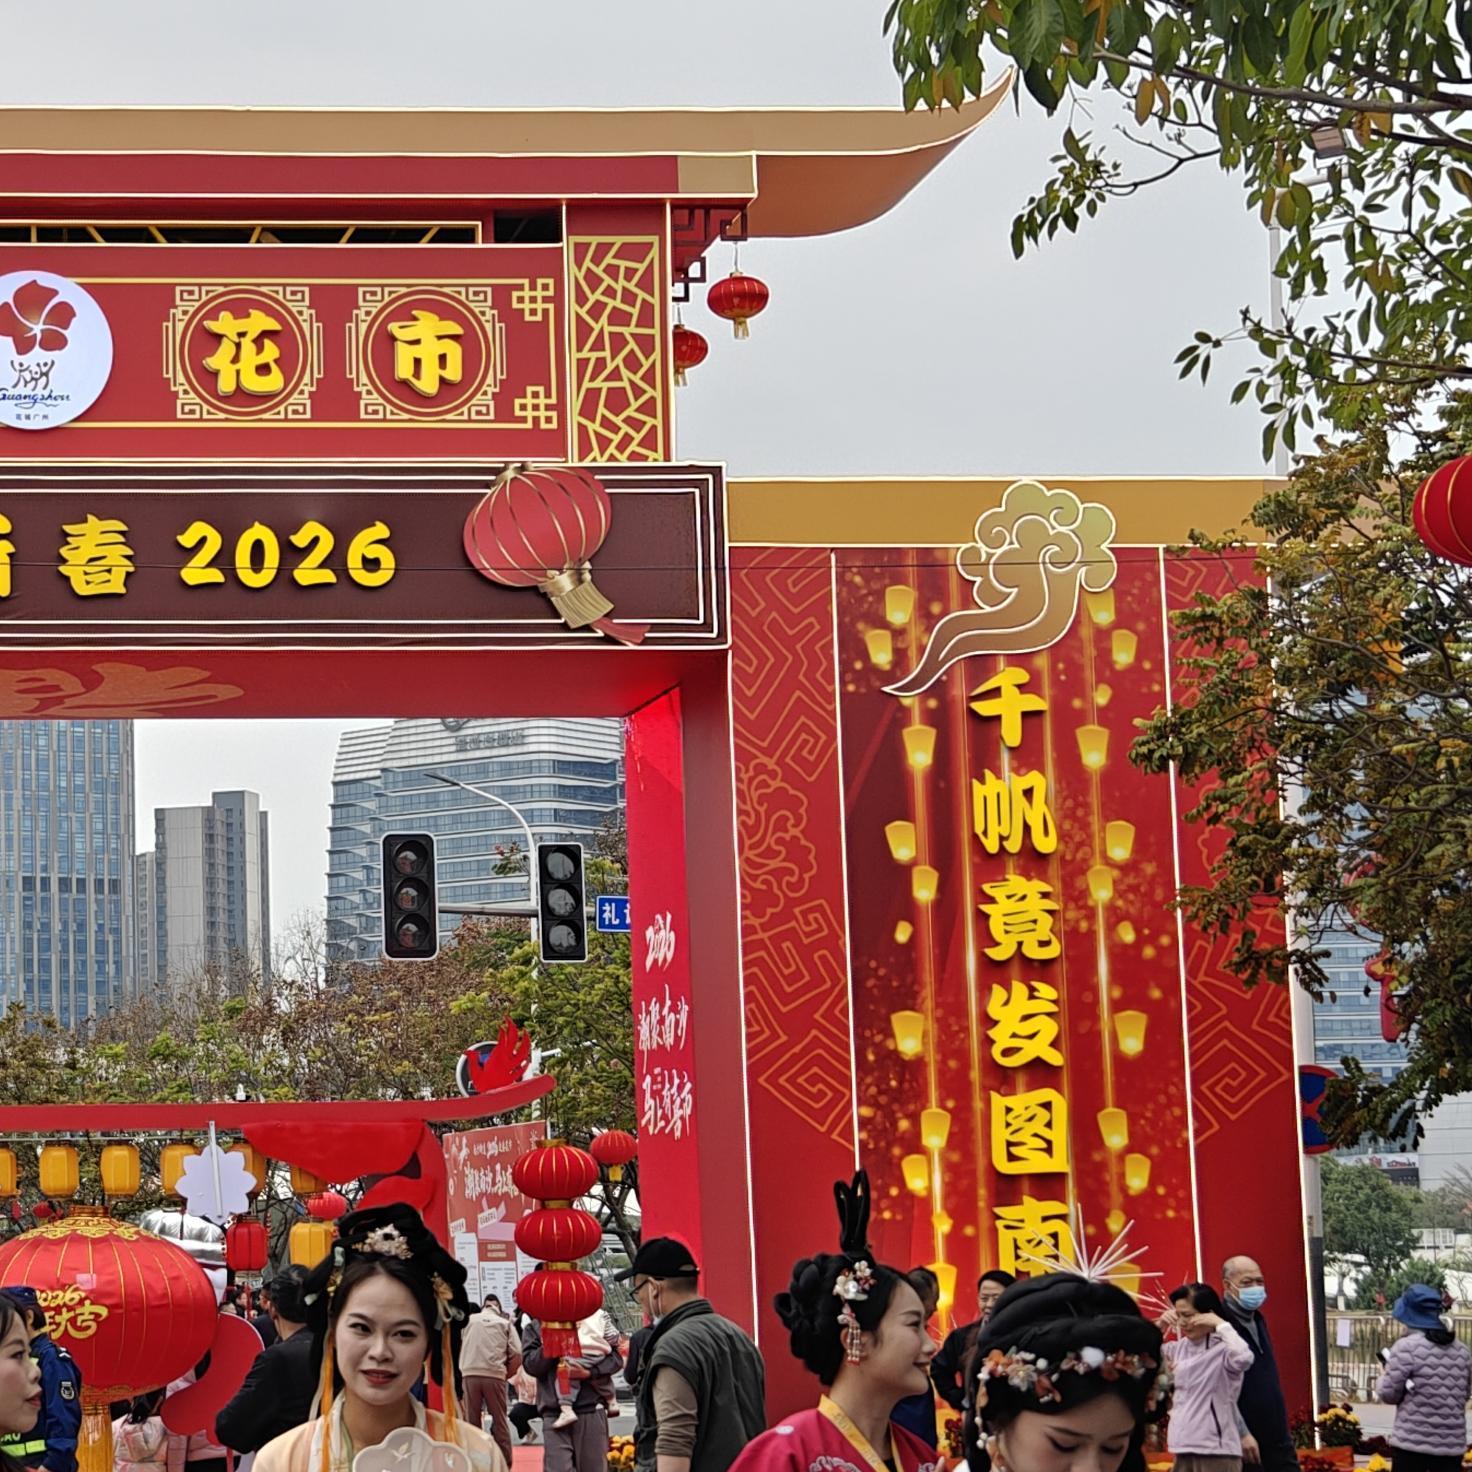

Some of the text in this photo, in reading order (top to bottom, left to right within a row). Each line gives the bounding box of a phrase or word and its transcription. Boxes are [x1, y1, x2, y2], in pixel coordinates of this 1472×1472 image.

[204, 308, 464, 395] 花市
[177, 521, 396, 588] 2026
[971, 666, 1074, 1278] 千帆竞发图南
